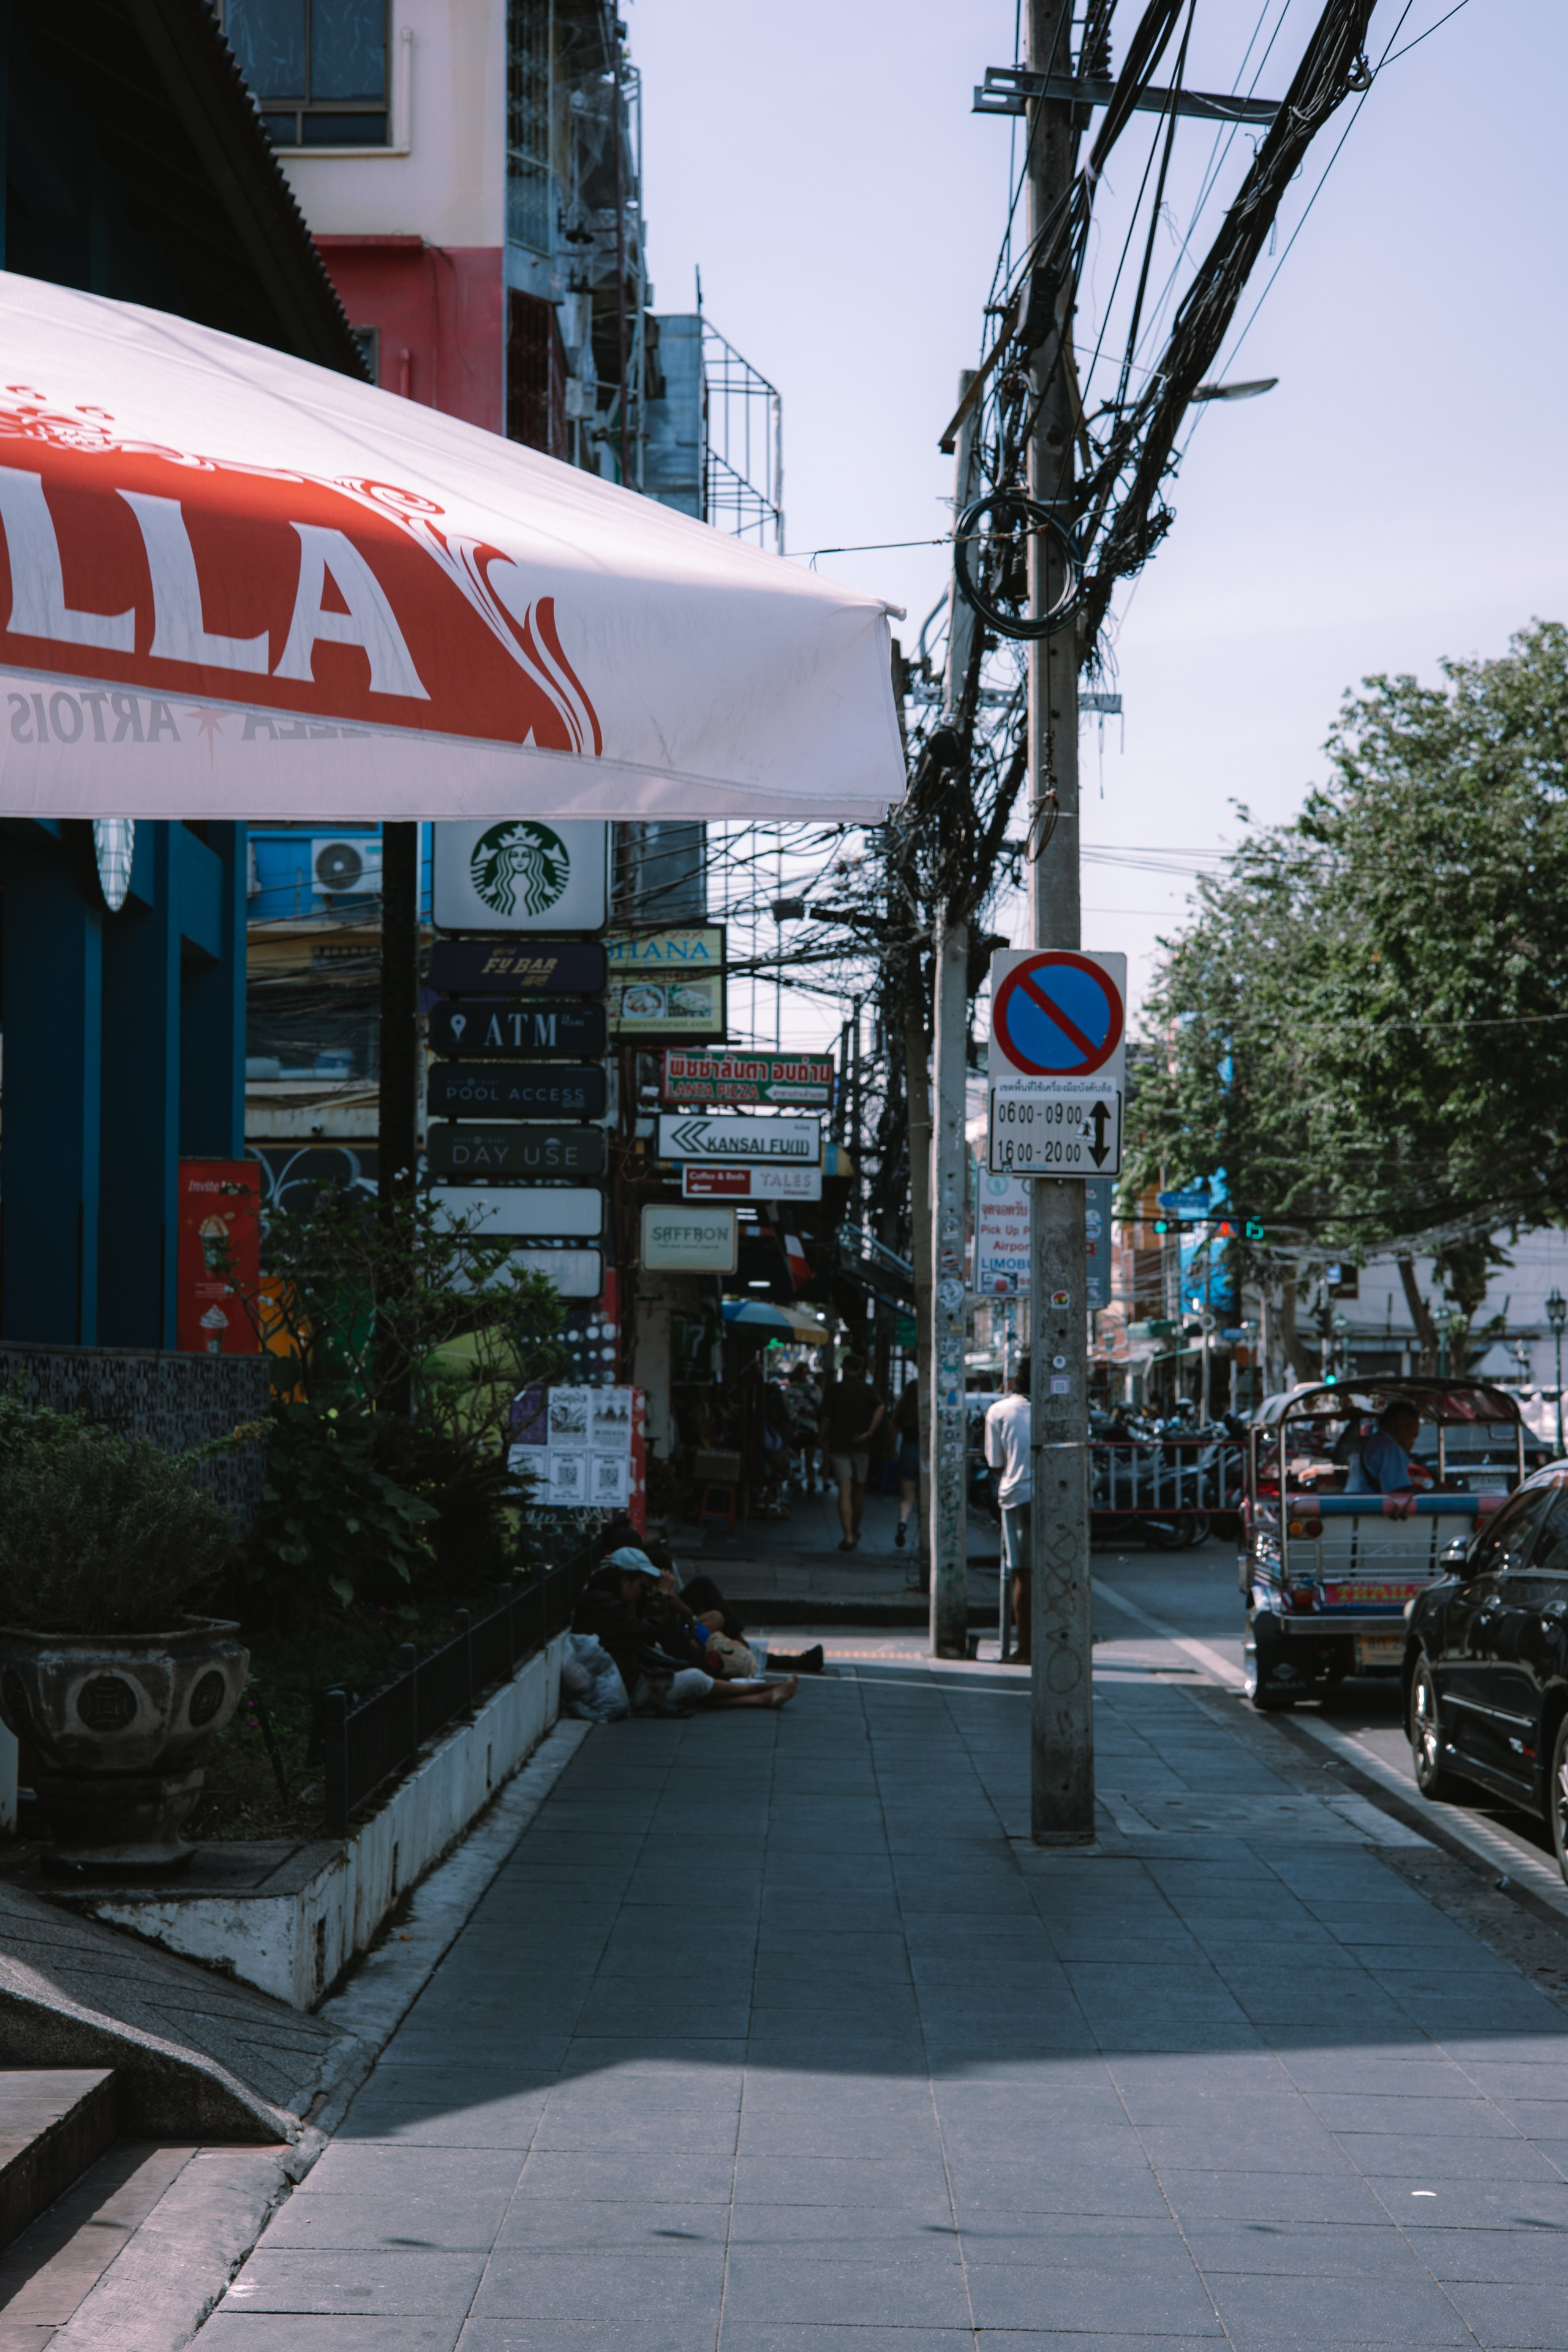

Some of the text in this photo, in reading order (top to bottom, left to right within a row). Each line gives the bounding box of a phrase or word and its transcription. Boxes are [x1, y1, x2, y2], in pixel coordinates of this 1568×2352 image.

[511, 957, 559, 974] BAR
[483, 1012, 557, 1047] ATM
[446, 1087, 585, 1101] POOL ACCESS
[669, 1082, 715, 1098] LANTA
[717, 1084, 760, 1099] PIZZA
[707, 1136, 764, 1153] KANSAI
[453, 1145, 579, 1166] DAY USE
[688, 1171, 746, 1181] Coffee & Beds
[760, 1173, 812, 1188] TALES
[651, 1226, 729, 1243] SAFFRON
[981, 1225, 1001, 1235] Pick
[1006, 1225, 1019, 1236] Up
